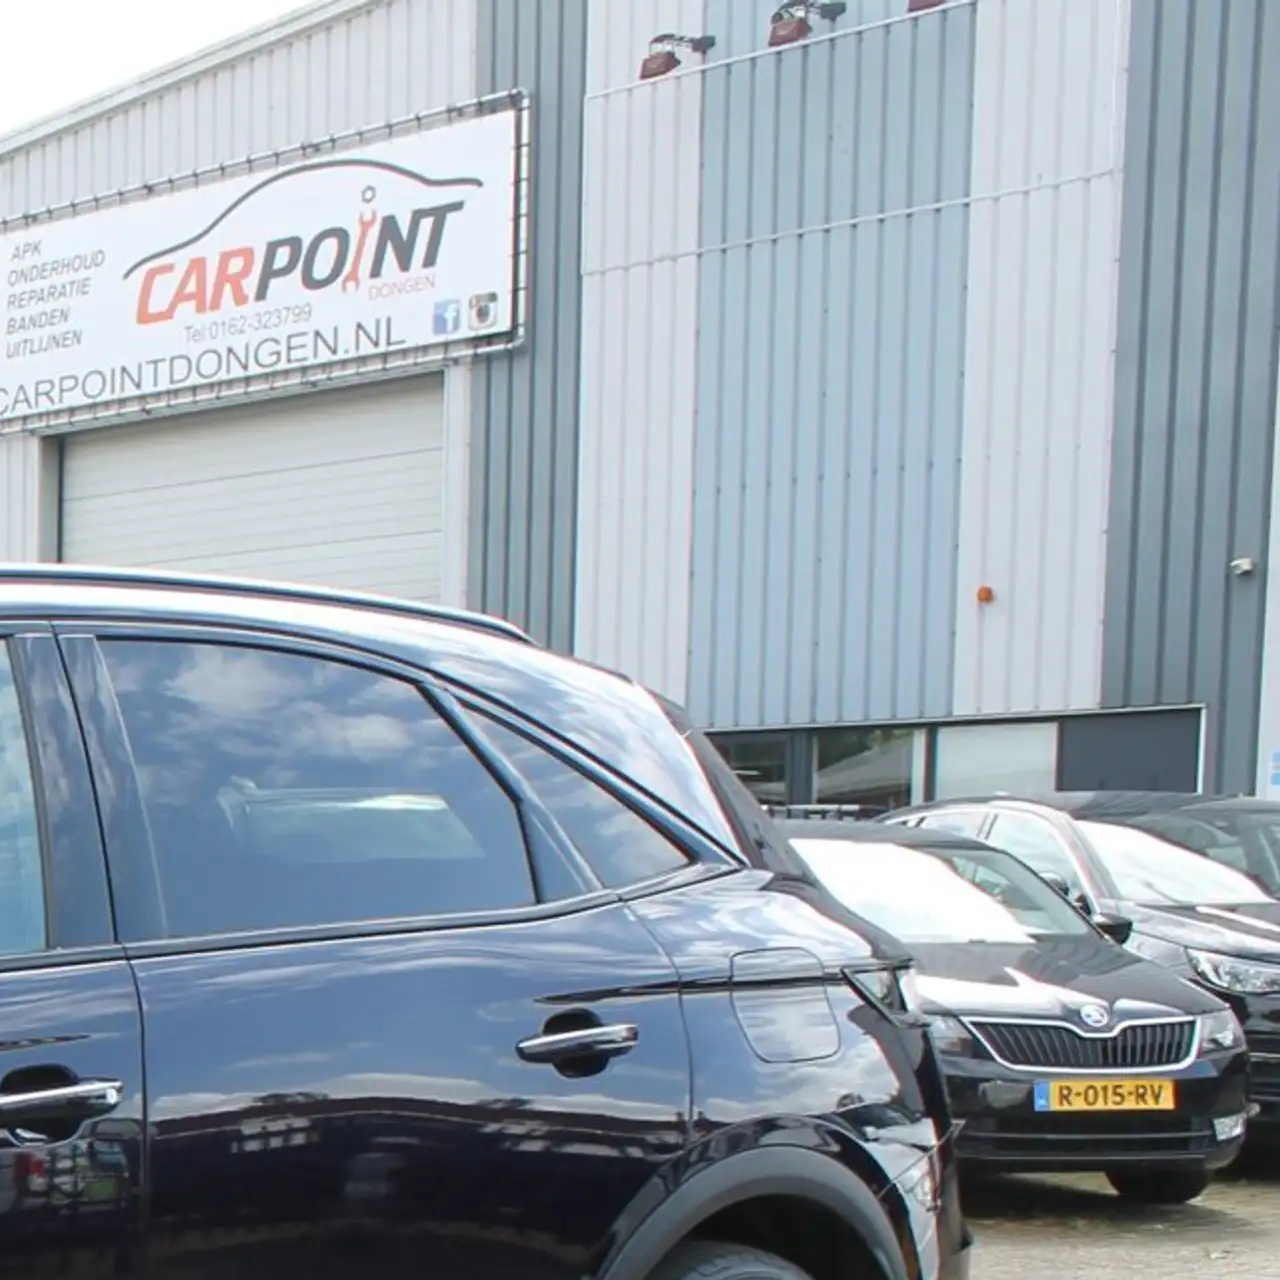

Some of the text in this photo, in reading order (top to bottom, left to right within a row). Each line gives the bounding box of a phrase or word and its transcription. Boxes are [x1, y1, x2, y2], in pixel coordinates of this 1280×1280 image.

[7, 249, 106, 288] ONDERHOUD
[136, 187, 465, 325] CARPOINT
[6, 277, 92, 313] REPARATIE
[368, 274, 436, 301] DONGEN
[5, 306, 71, 336] BANDEN
[1058, 1083, 1164, 1107] R-015-RV
